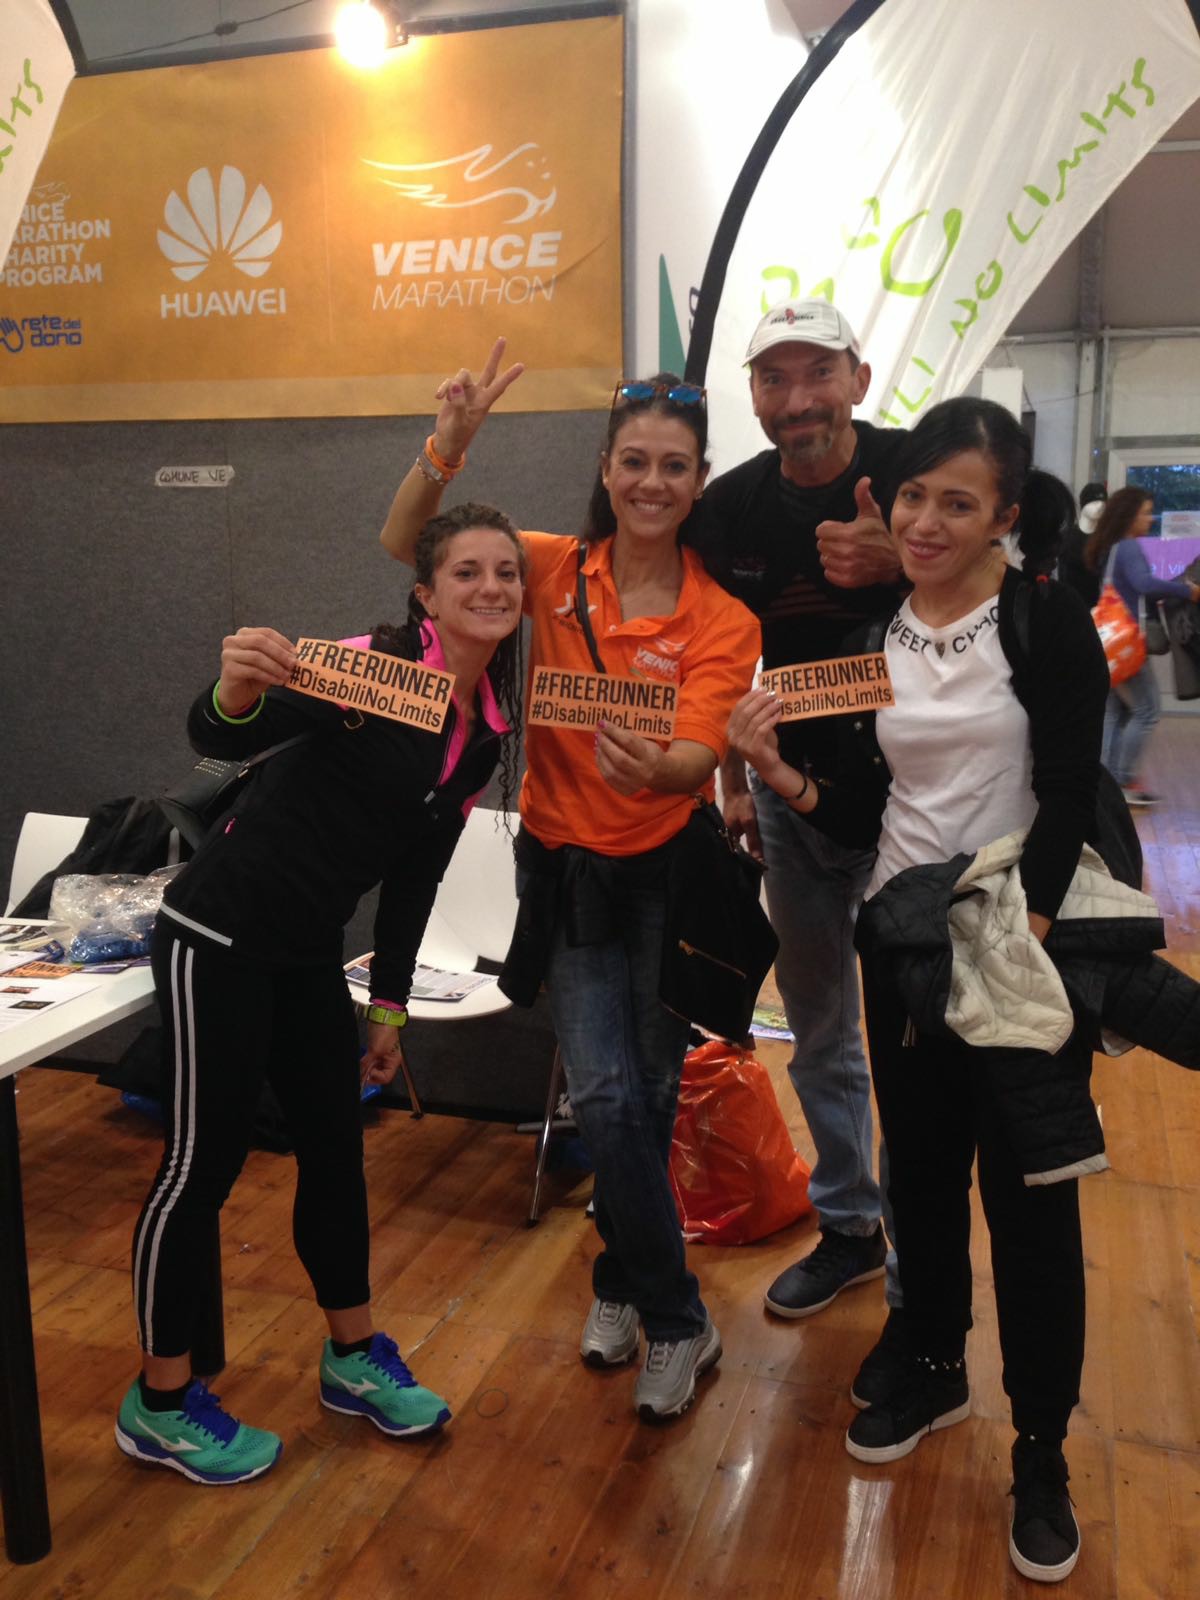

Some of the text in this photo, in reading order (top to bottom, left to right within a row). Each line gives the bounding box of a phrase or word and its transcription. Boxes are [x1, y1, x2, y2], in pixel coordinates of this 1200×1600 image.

[371, 231, 562, 276] VENICE
[160, 287, 286, 319] HUAWEI
[373, 274, 557, 311] MARATHON
[22, 314, 62, 331] rete
[31, 329, 82, 347] dono
[295, 640, 451, 704] #FREERUNNER
[289, 665, 442, 728] #DisabiliNoLimits
[536, 671, 677, 712] #FREERUNNER
[532, 700, 672, 736] #DisabiliNoLimits
